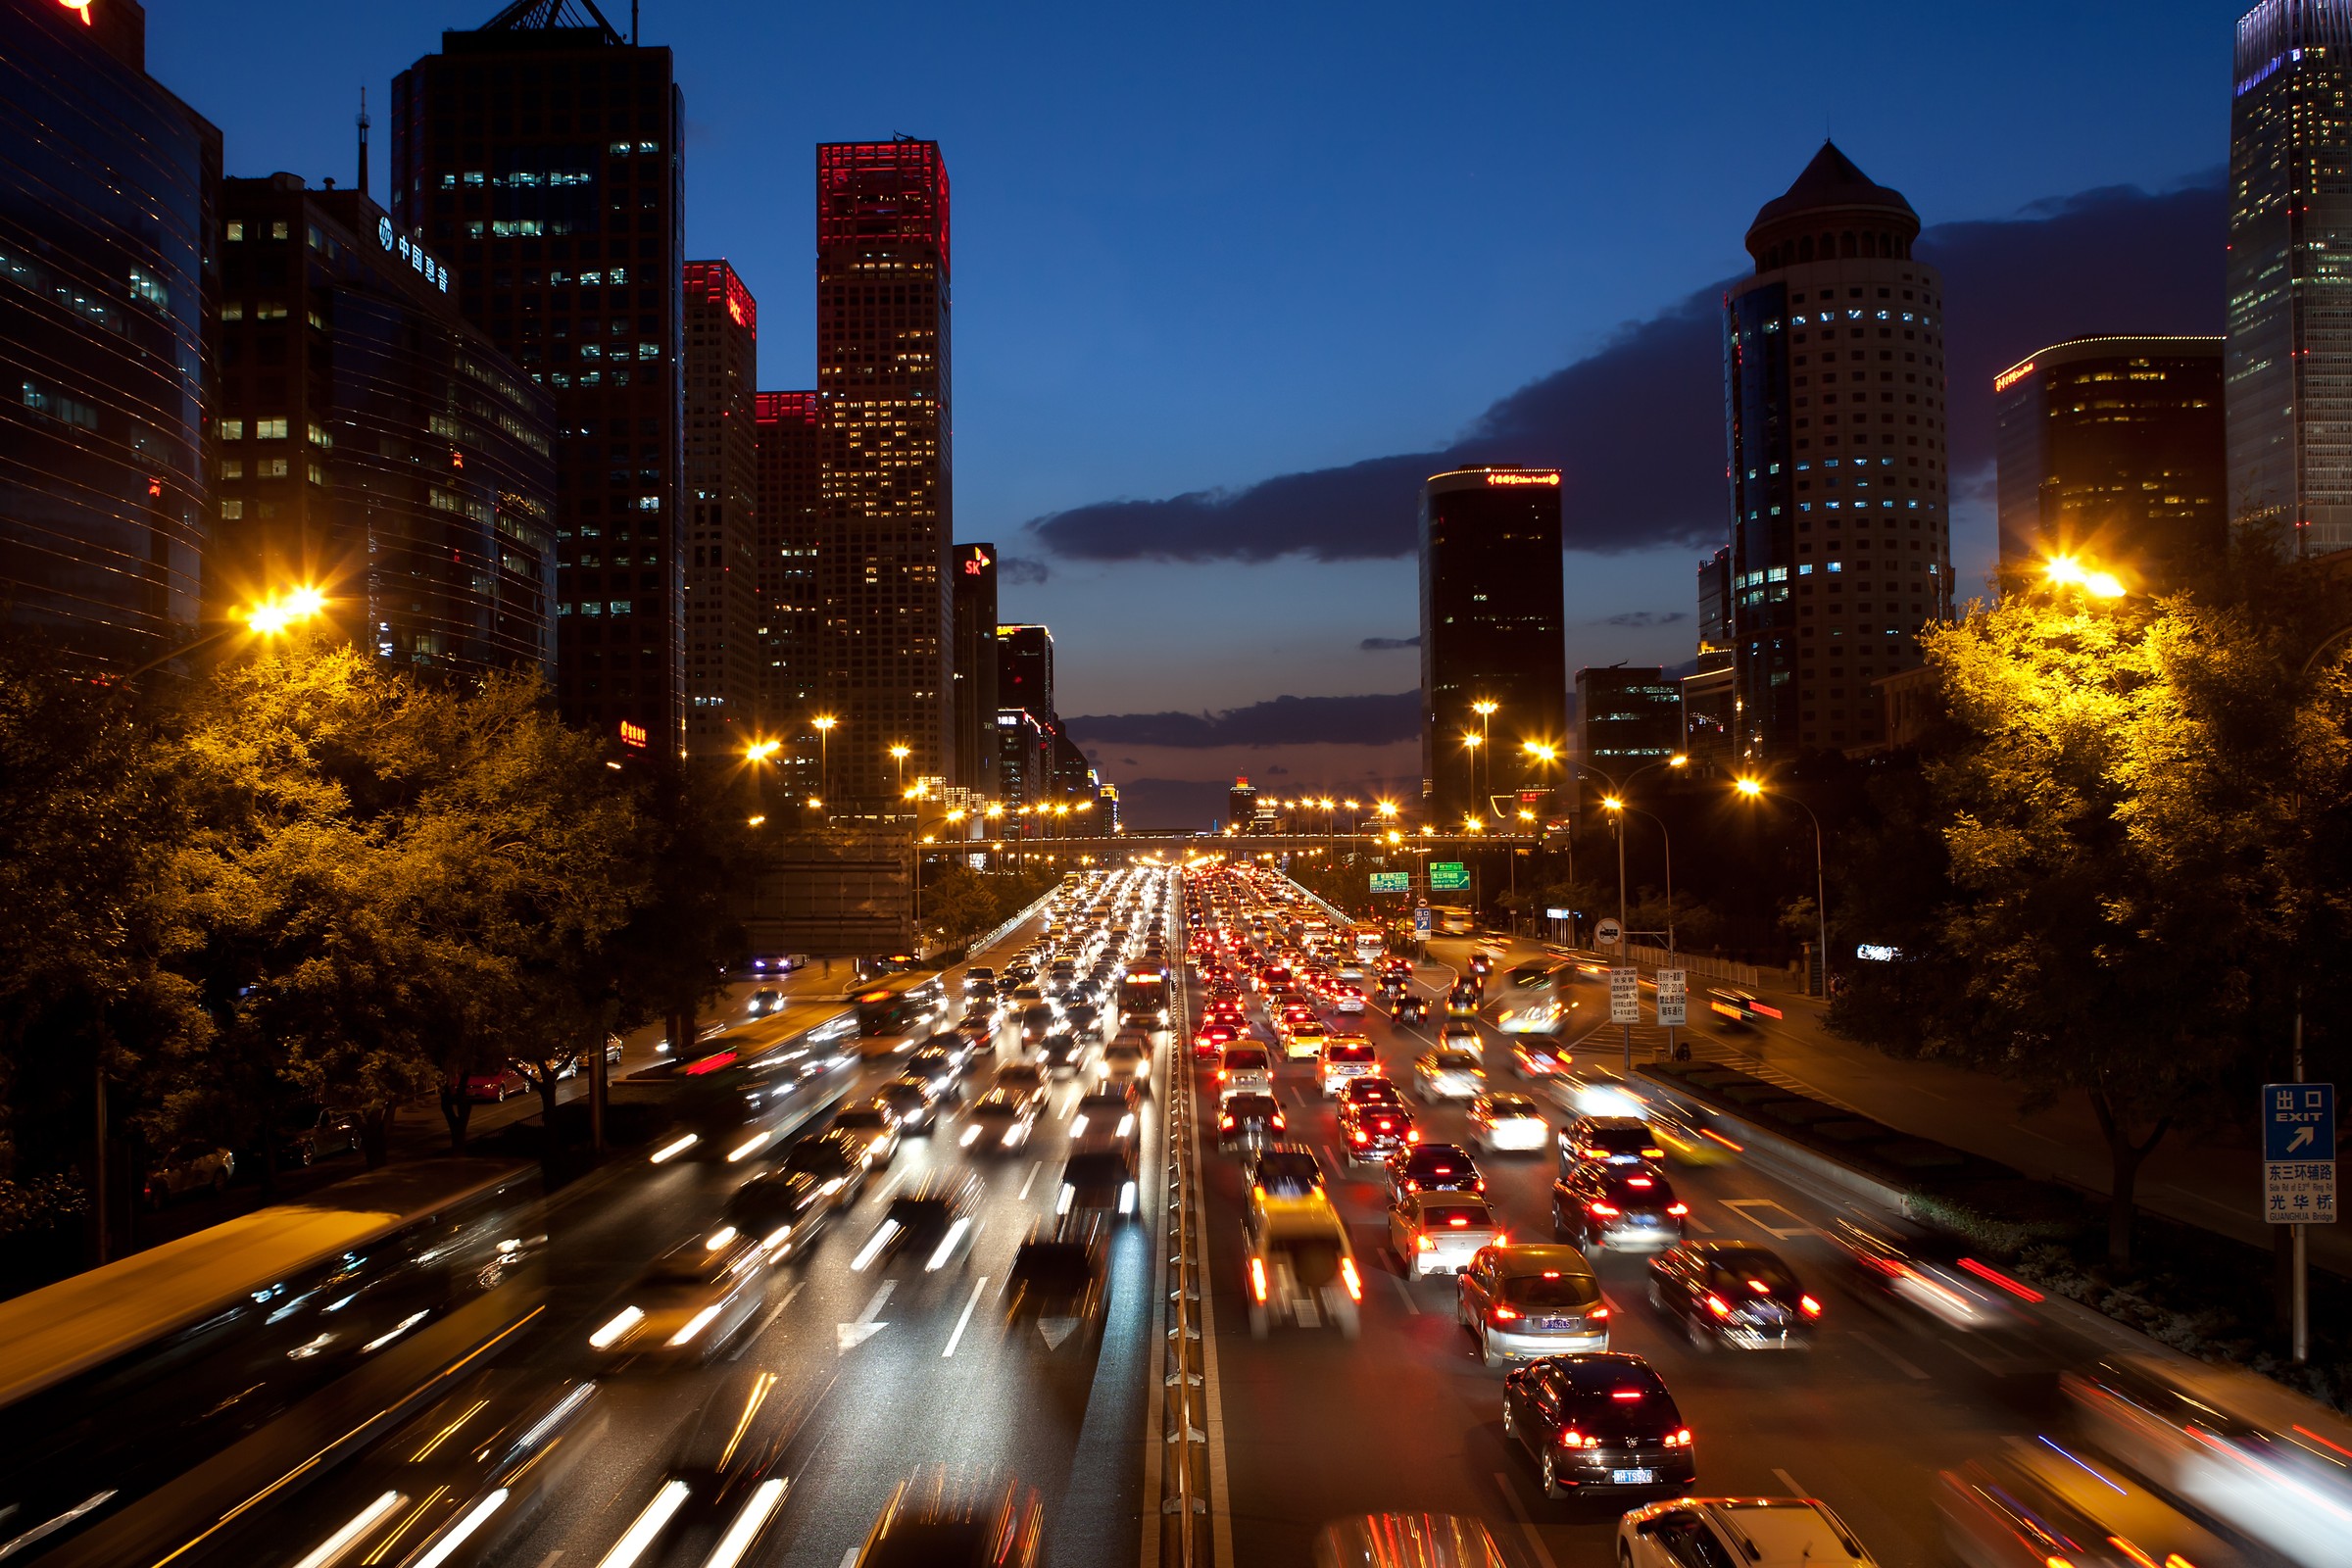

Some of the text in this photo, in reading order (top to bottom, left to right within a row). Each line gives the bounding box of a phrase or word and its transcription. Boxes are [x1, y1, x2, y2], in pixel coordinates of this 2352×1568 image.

[398, 234, 449, 294] 中国惠普
[965, 560, 981, 575] SK
[1661, 1006, 1684, 1015] 租车通行
[2276, 1090, 2323, 1110] 出口
[2276, 1112, 2324, 1122] EXIT
[2269, 1164, 2333, 1181] 东三环辅路
[2269, 1183, 2280, 1192] Side
[2281, 1183, 2289, 1192] Rd
[2290, 1183, 2297, 1192] of
[2312, 1183, 2325, 1193] Ring
[2326, 1183, 2333, 1192] Rd
[2270, 1194, 2333, 1210] 光华桥
[2270, 1211, 2334, 1222] GUANGHUA Bridge
